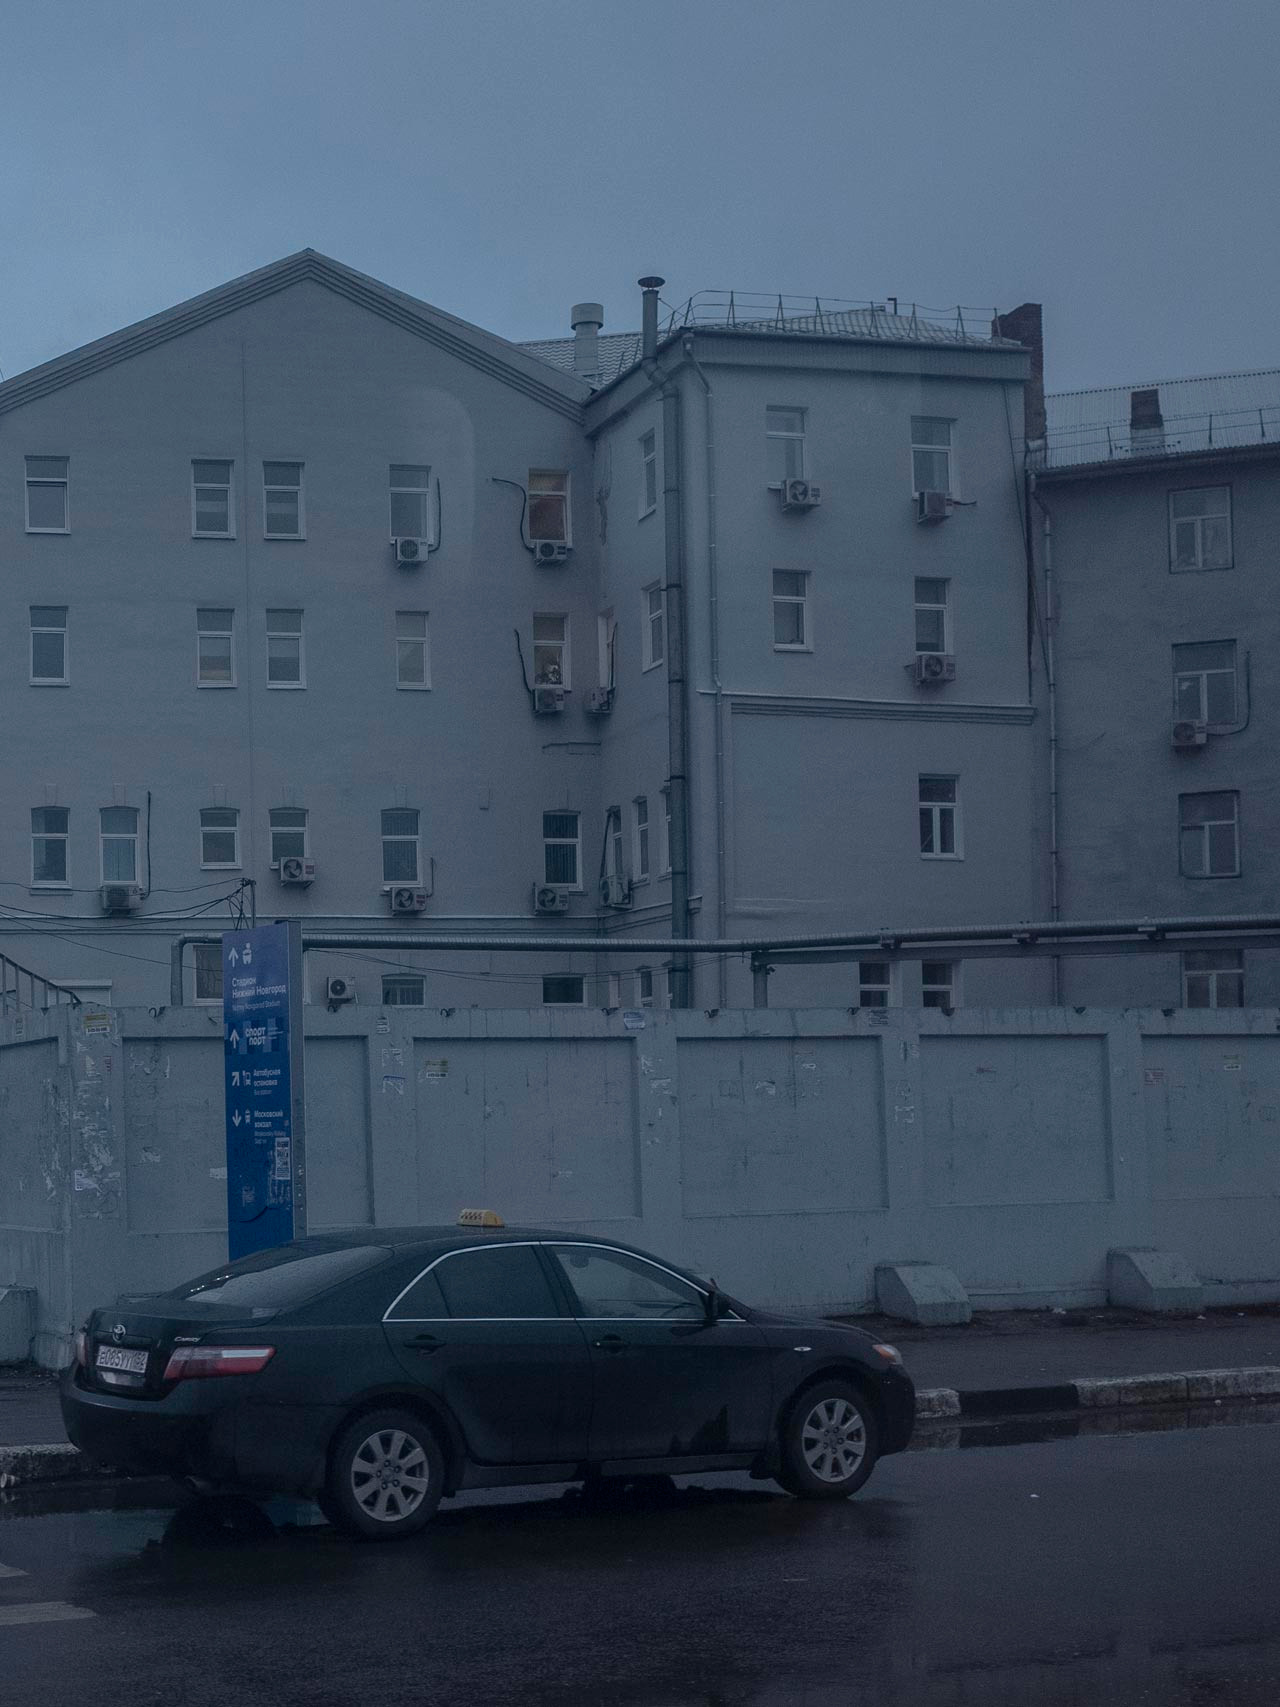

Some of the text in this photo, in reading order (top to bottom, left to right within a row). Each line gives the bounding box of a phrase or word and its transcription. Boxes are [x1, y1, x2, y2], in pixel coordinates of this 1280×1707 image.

[231, 977, 257, 987] Стадион
[256, 984, 287, 996] Новгород
[245, 1027, 266, 1037] спорт
[248, 1036, 266, 1046] порт
